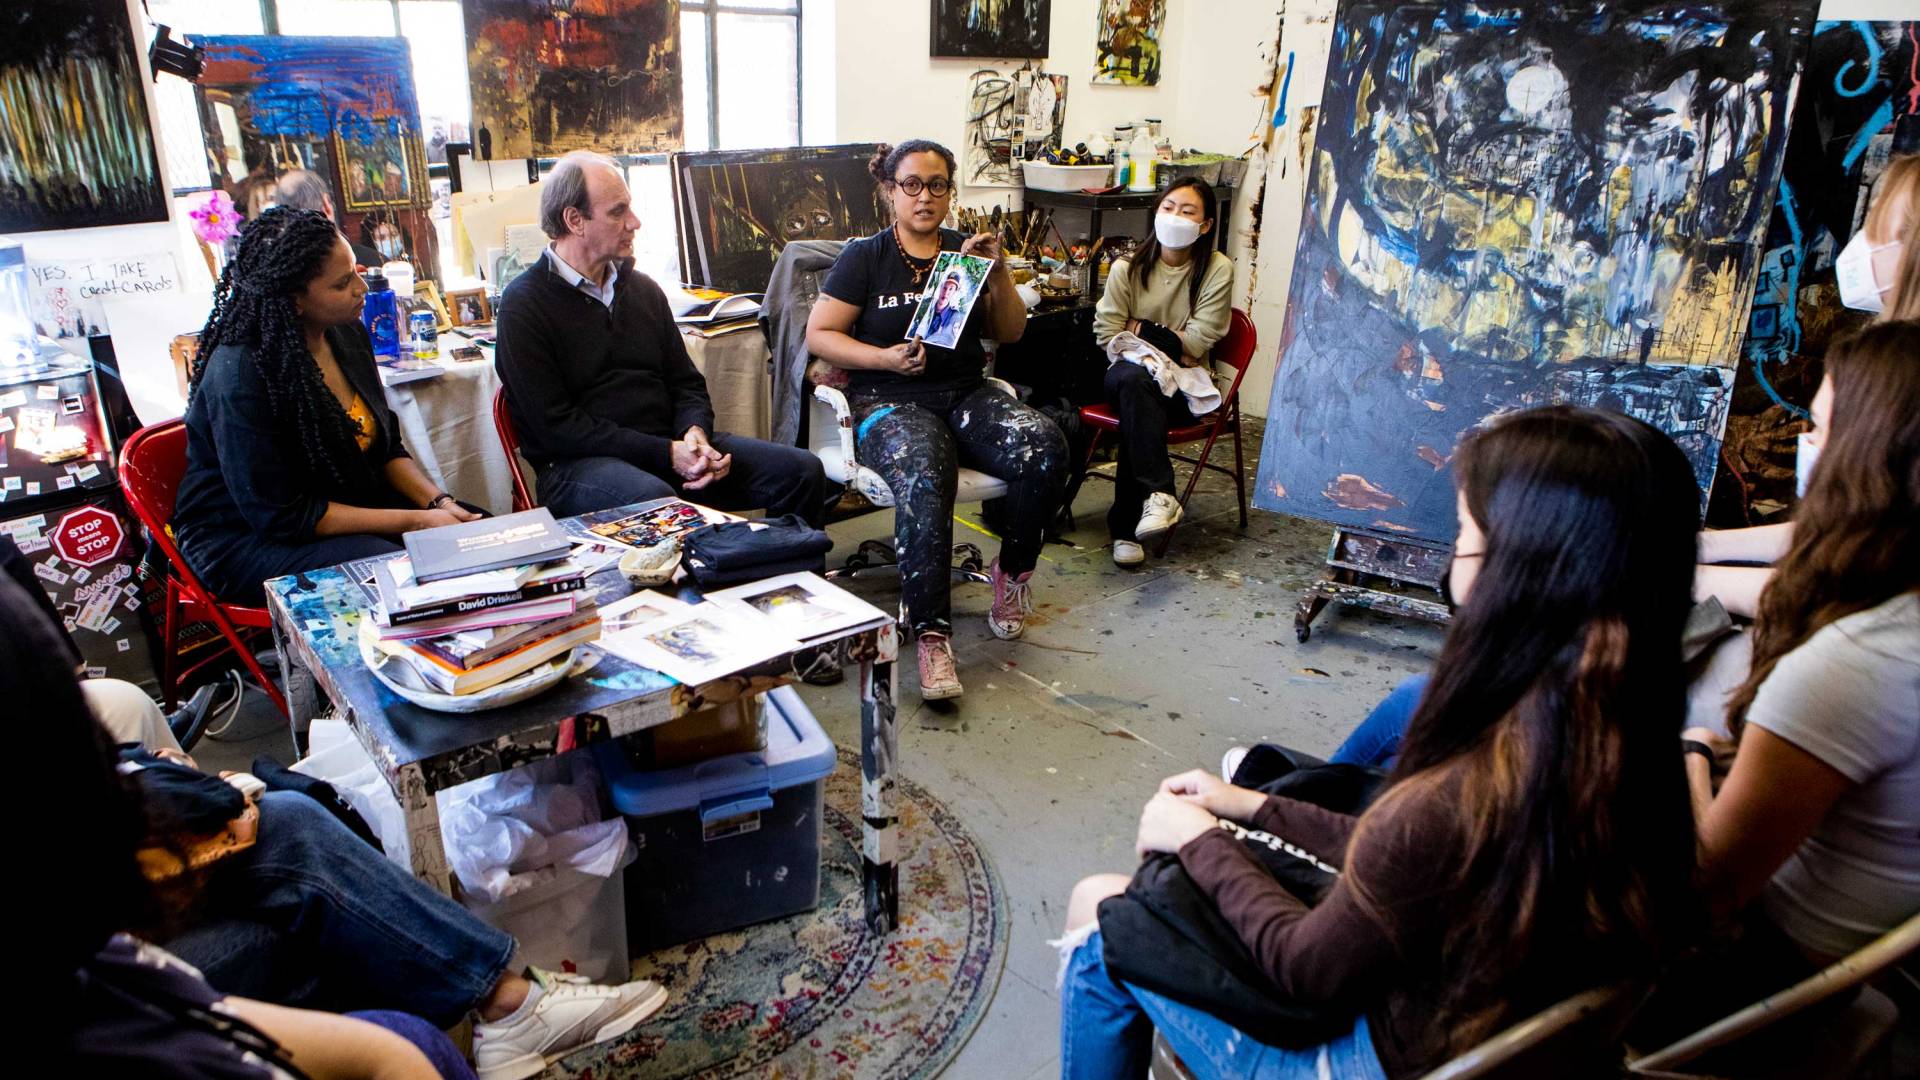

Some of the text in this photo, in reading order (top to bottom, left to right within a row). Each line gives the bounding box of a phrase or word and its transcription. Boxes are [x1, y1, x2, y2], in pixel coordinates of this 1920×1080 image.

[80, 264, 96, 282] I
[109, 262, 149, 278] TAKE
[878, 295, 898, 309] La
[68, 518, 102, 538] STOP
[77, 530, 102, 543] means
[76, 535, 111, 555] STOP
[74, 564, 131, 600] sweet
[458, 591, 522, 611] David Driskell
